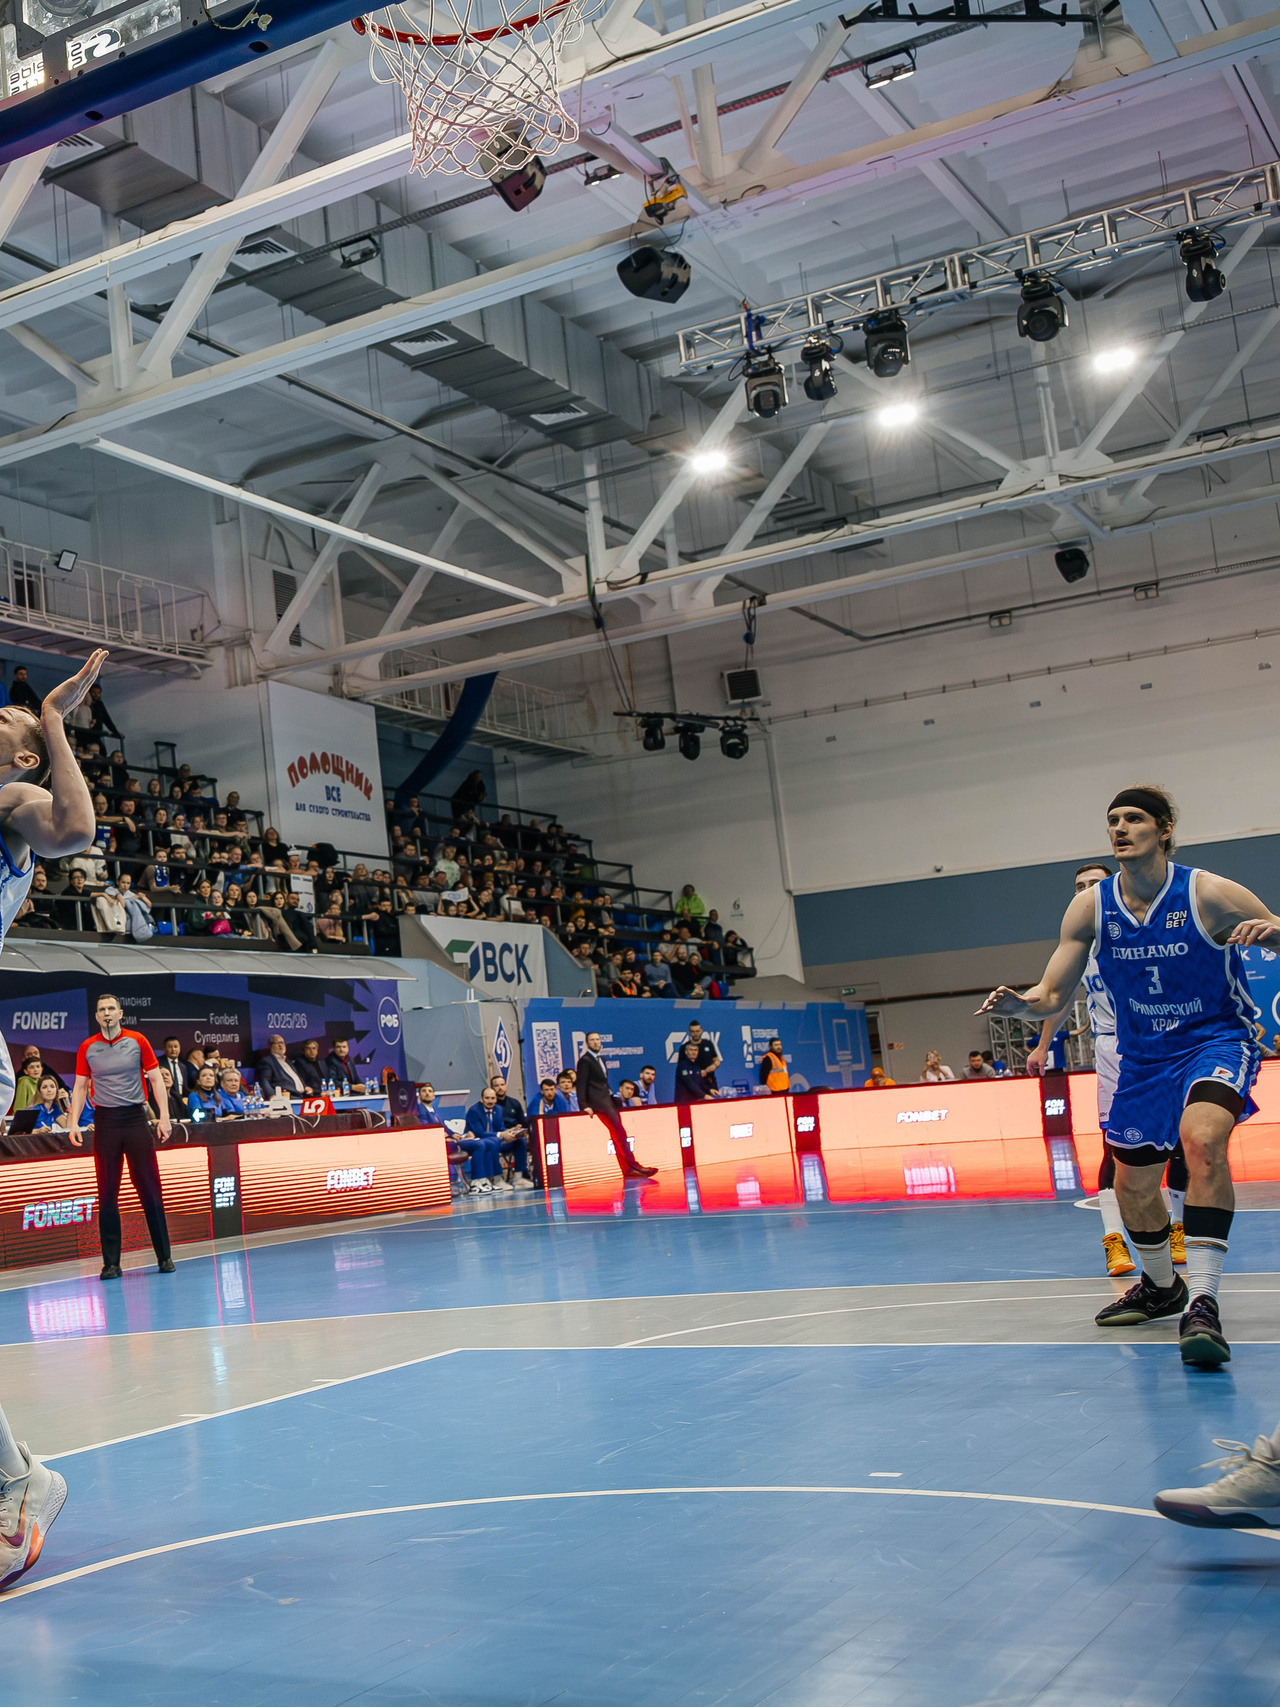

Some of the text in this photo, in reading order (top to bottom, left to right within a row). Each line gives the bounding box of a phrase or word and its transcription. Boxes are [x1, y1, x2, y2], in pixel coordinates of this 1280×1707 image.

[286, 752, 373, 801] ПОМОЩНИК
[732, 900, 740, 911] 6
[1166, 909, 1188, 921] FON
[1165, 919, 1187, 929] BET
[1111, 942, 1189, 960] ДИНАМО
[481, 941, 533, 986] ВСК
[1145, 965, 1164, 995] 3
[117, 996, 152, 1007] пионат
[1128, 997, 1203, 1016] ПРИМОРСКИЙ
[12, 1011, 68, 1030] FONBET
[209, 1012, 239, 1026] Fonbet
[267, 1012, 308, 1030] 2025/26
[1151, 1017, 1180, 1032] КРАЙ
[194, 1030, 240, 1045] Суперлига
[303, 1098, 326, 1115] 5
[896, 1109, 949, 1124] FONBET
[326, 1166, 377, 1191] FONBET
[22, 1196, 96, 1231] FONBET
